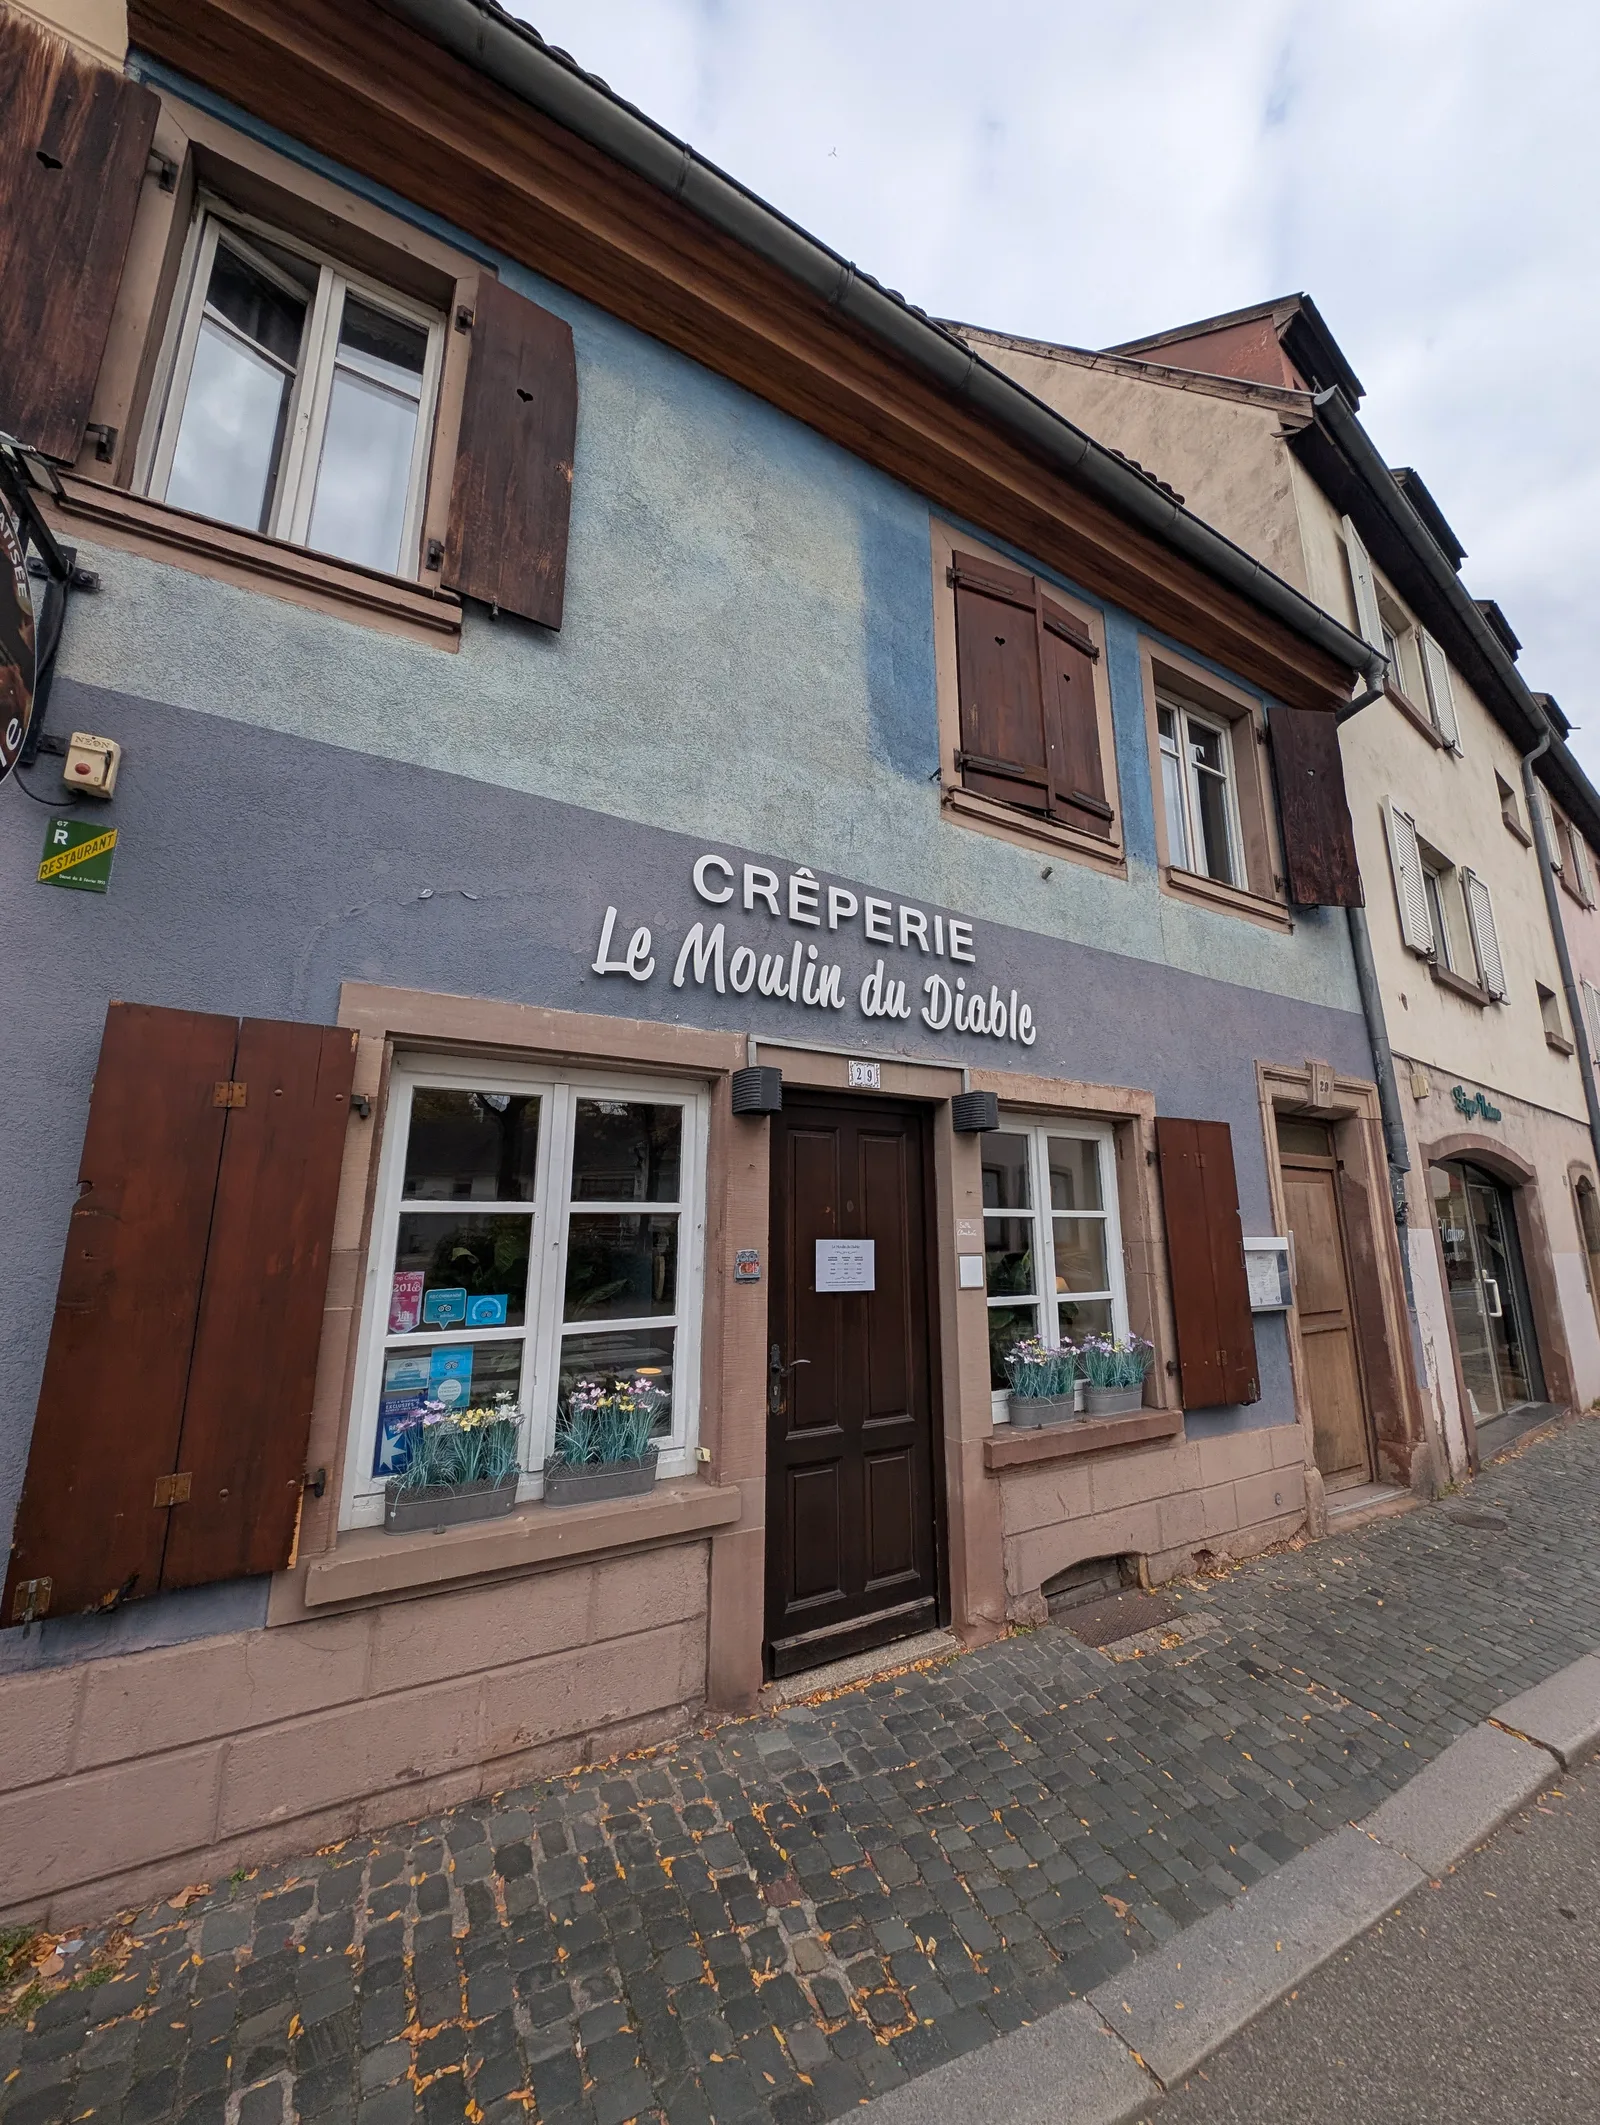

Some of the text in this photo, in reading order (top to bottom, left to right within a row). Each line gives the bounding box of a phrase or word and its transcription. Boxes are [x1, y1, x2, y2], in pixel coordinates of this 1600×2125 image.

[41, 834, 113, 877] RESTAURANT
[53, 829, 68, 845] R
[692, 853, 976, 963] CRÊPERIE
[591, 905, 1036, 1046] Le Moulin du Diable
[856, 1067, 873, 1083] 29
